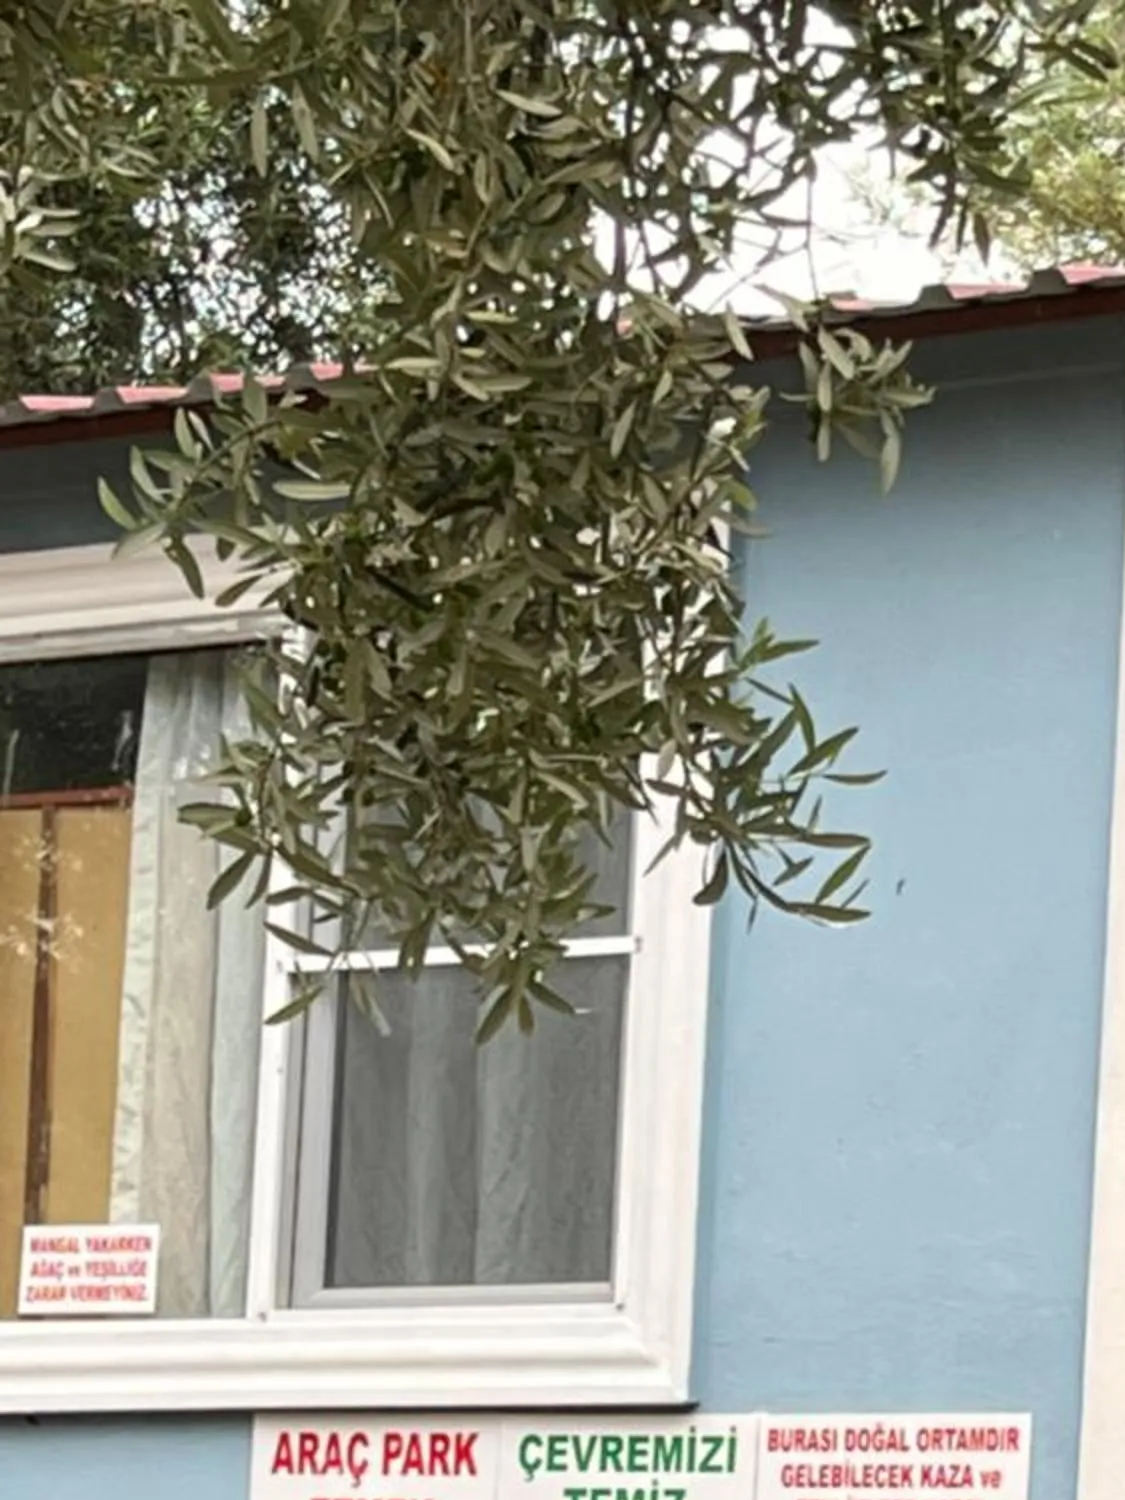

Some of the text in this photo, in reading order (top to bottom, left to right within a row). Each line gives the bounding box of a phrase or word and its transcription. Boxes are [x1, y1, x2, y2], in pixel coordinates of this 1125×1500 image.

[270, 1431, 480, 1486] ARAÇ PARK
[517, 1425, 738, 1482] ÇEVREMİZİ
[767, 1423, 1019, 1453] BURASI DOĞAL ORTAMDIR
[780, 1460, 1001, 1489] GELEBİLECEK KAZA ve
